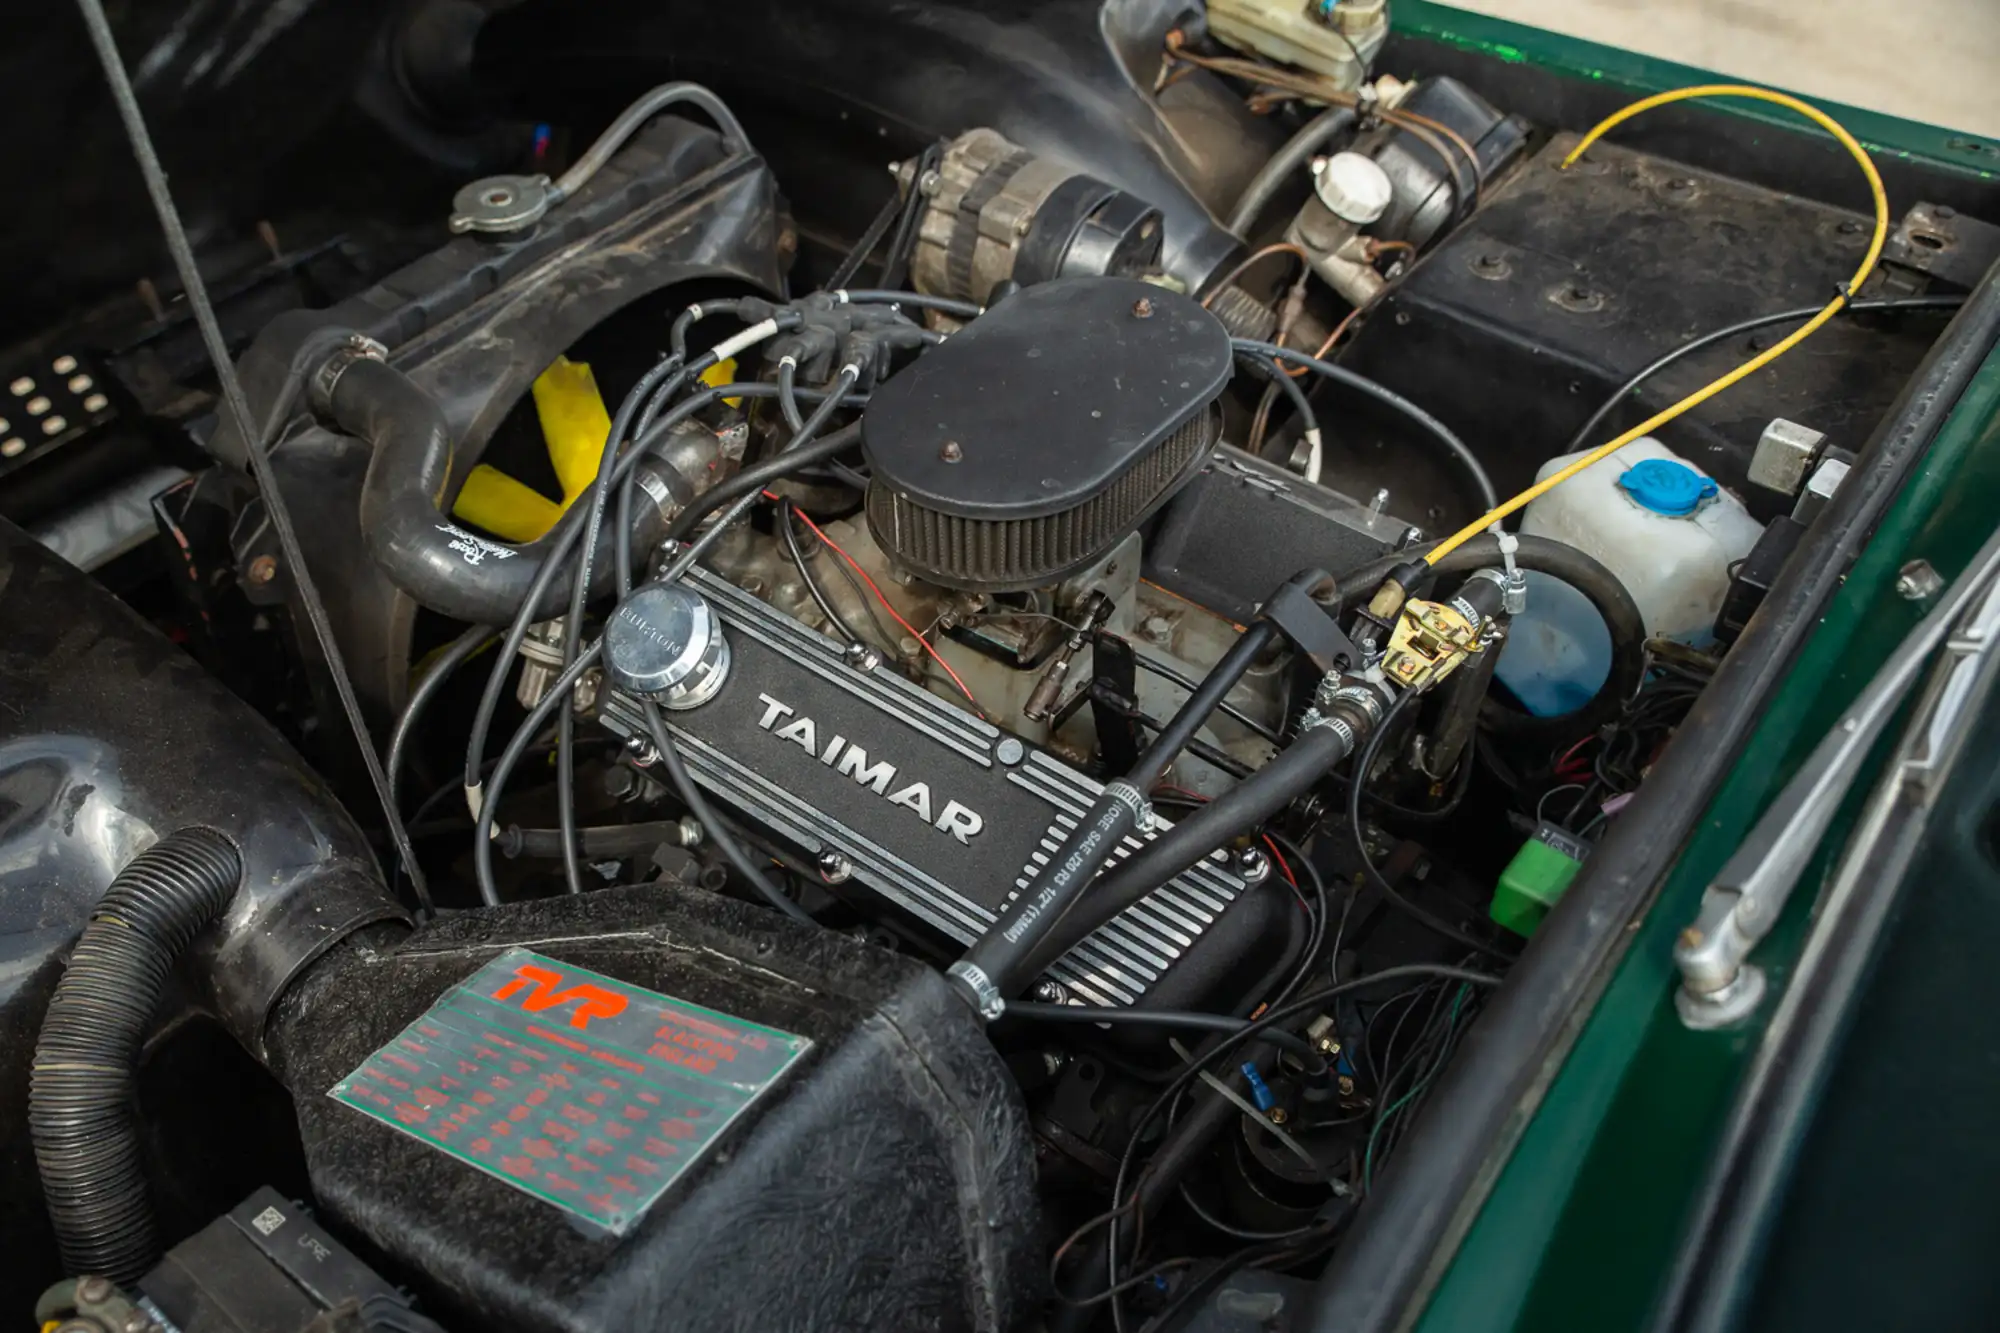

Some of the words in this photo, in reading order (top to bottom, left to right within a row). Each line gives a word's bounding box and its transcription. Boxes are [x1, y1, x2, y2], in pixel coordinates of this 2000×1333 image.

[757, 692, 984, 846] TAIMAR
[1097, 800, 1127, 832] HOSE
[1066, 849, 1088, 873] J20
[1080, 830, 1102, 856] SAE
[1002, 903, 1041, 944] (13MM)
[491, 964, 629, 1030] TVR
